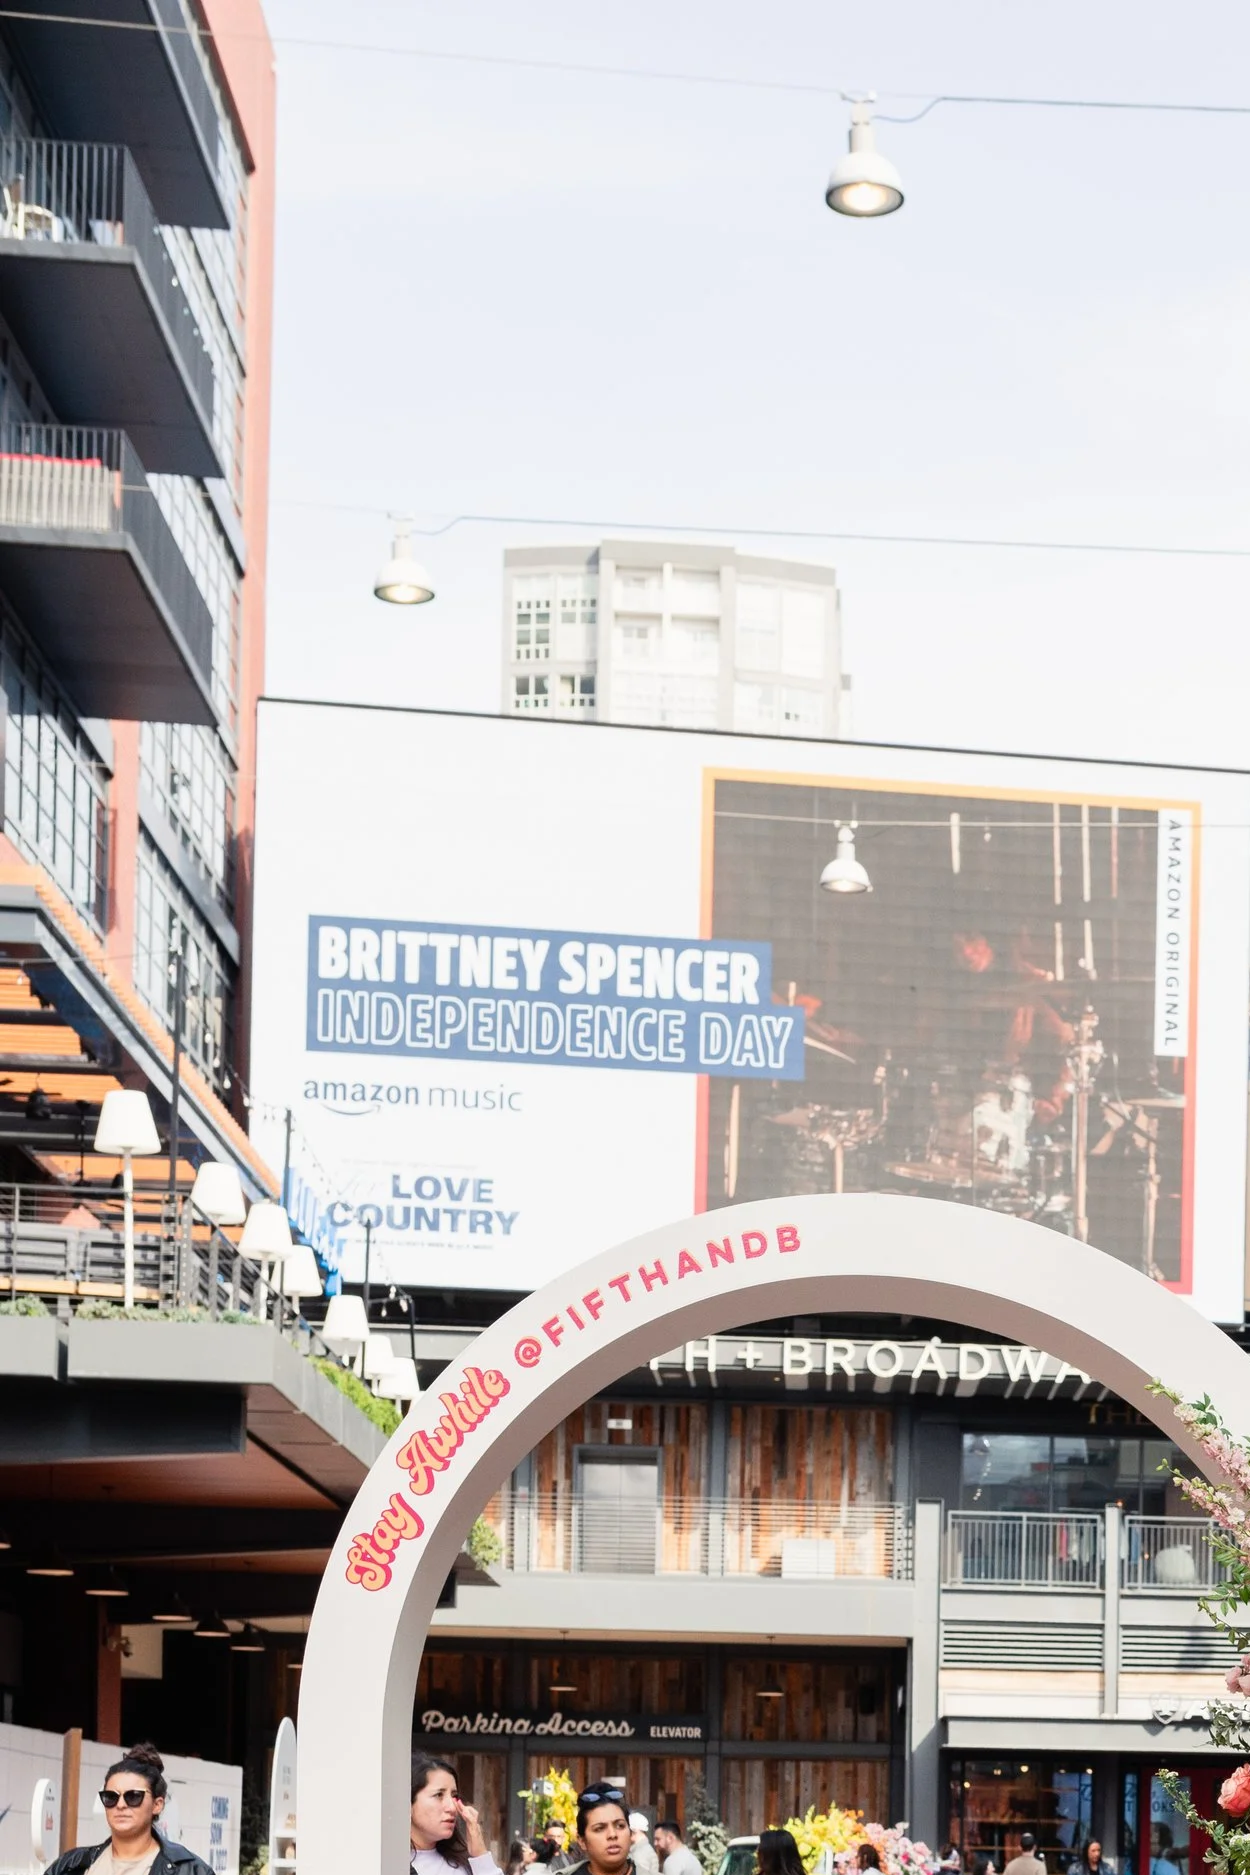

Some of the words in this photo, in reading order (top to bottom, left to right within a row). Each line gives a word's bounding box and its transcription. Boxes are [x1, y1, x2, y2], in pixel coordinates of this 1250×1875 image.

[1167, 819, 1182, 920] AMAZON
[317, 925, 550, 992] BRITTNEY
[558, 940, 761, 1005] SPENCER
[1164, 931, 1181, 1047] ORIGINAL
[316, 987, 687, 1063] INDEPENDENCE
[699, 1012, 795, 1070] DAY
[303, 1080, 420, 1107] amazon
[427, 1083, 523, 1112] music
[326, 1200, 522, 1236] COUNTRY
[391, 1173, 495, 1204] LOVE
[783, 1336, 1092, 1384] BROADWA
[345, 1492, 425, 1592] Stay
[396, 1366, 511, 1496] Awhile
[514, 1223, 801, 1369] @FIFTHANDB
[535, 1712, 635, 1738] Access
[650, 1725, 702, 1739] ELEVATOR
